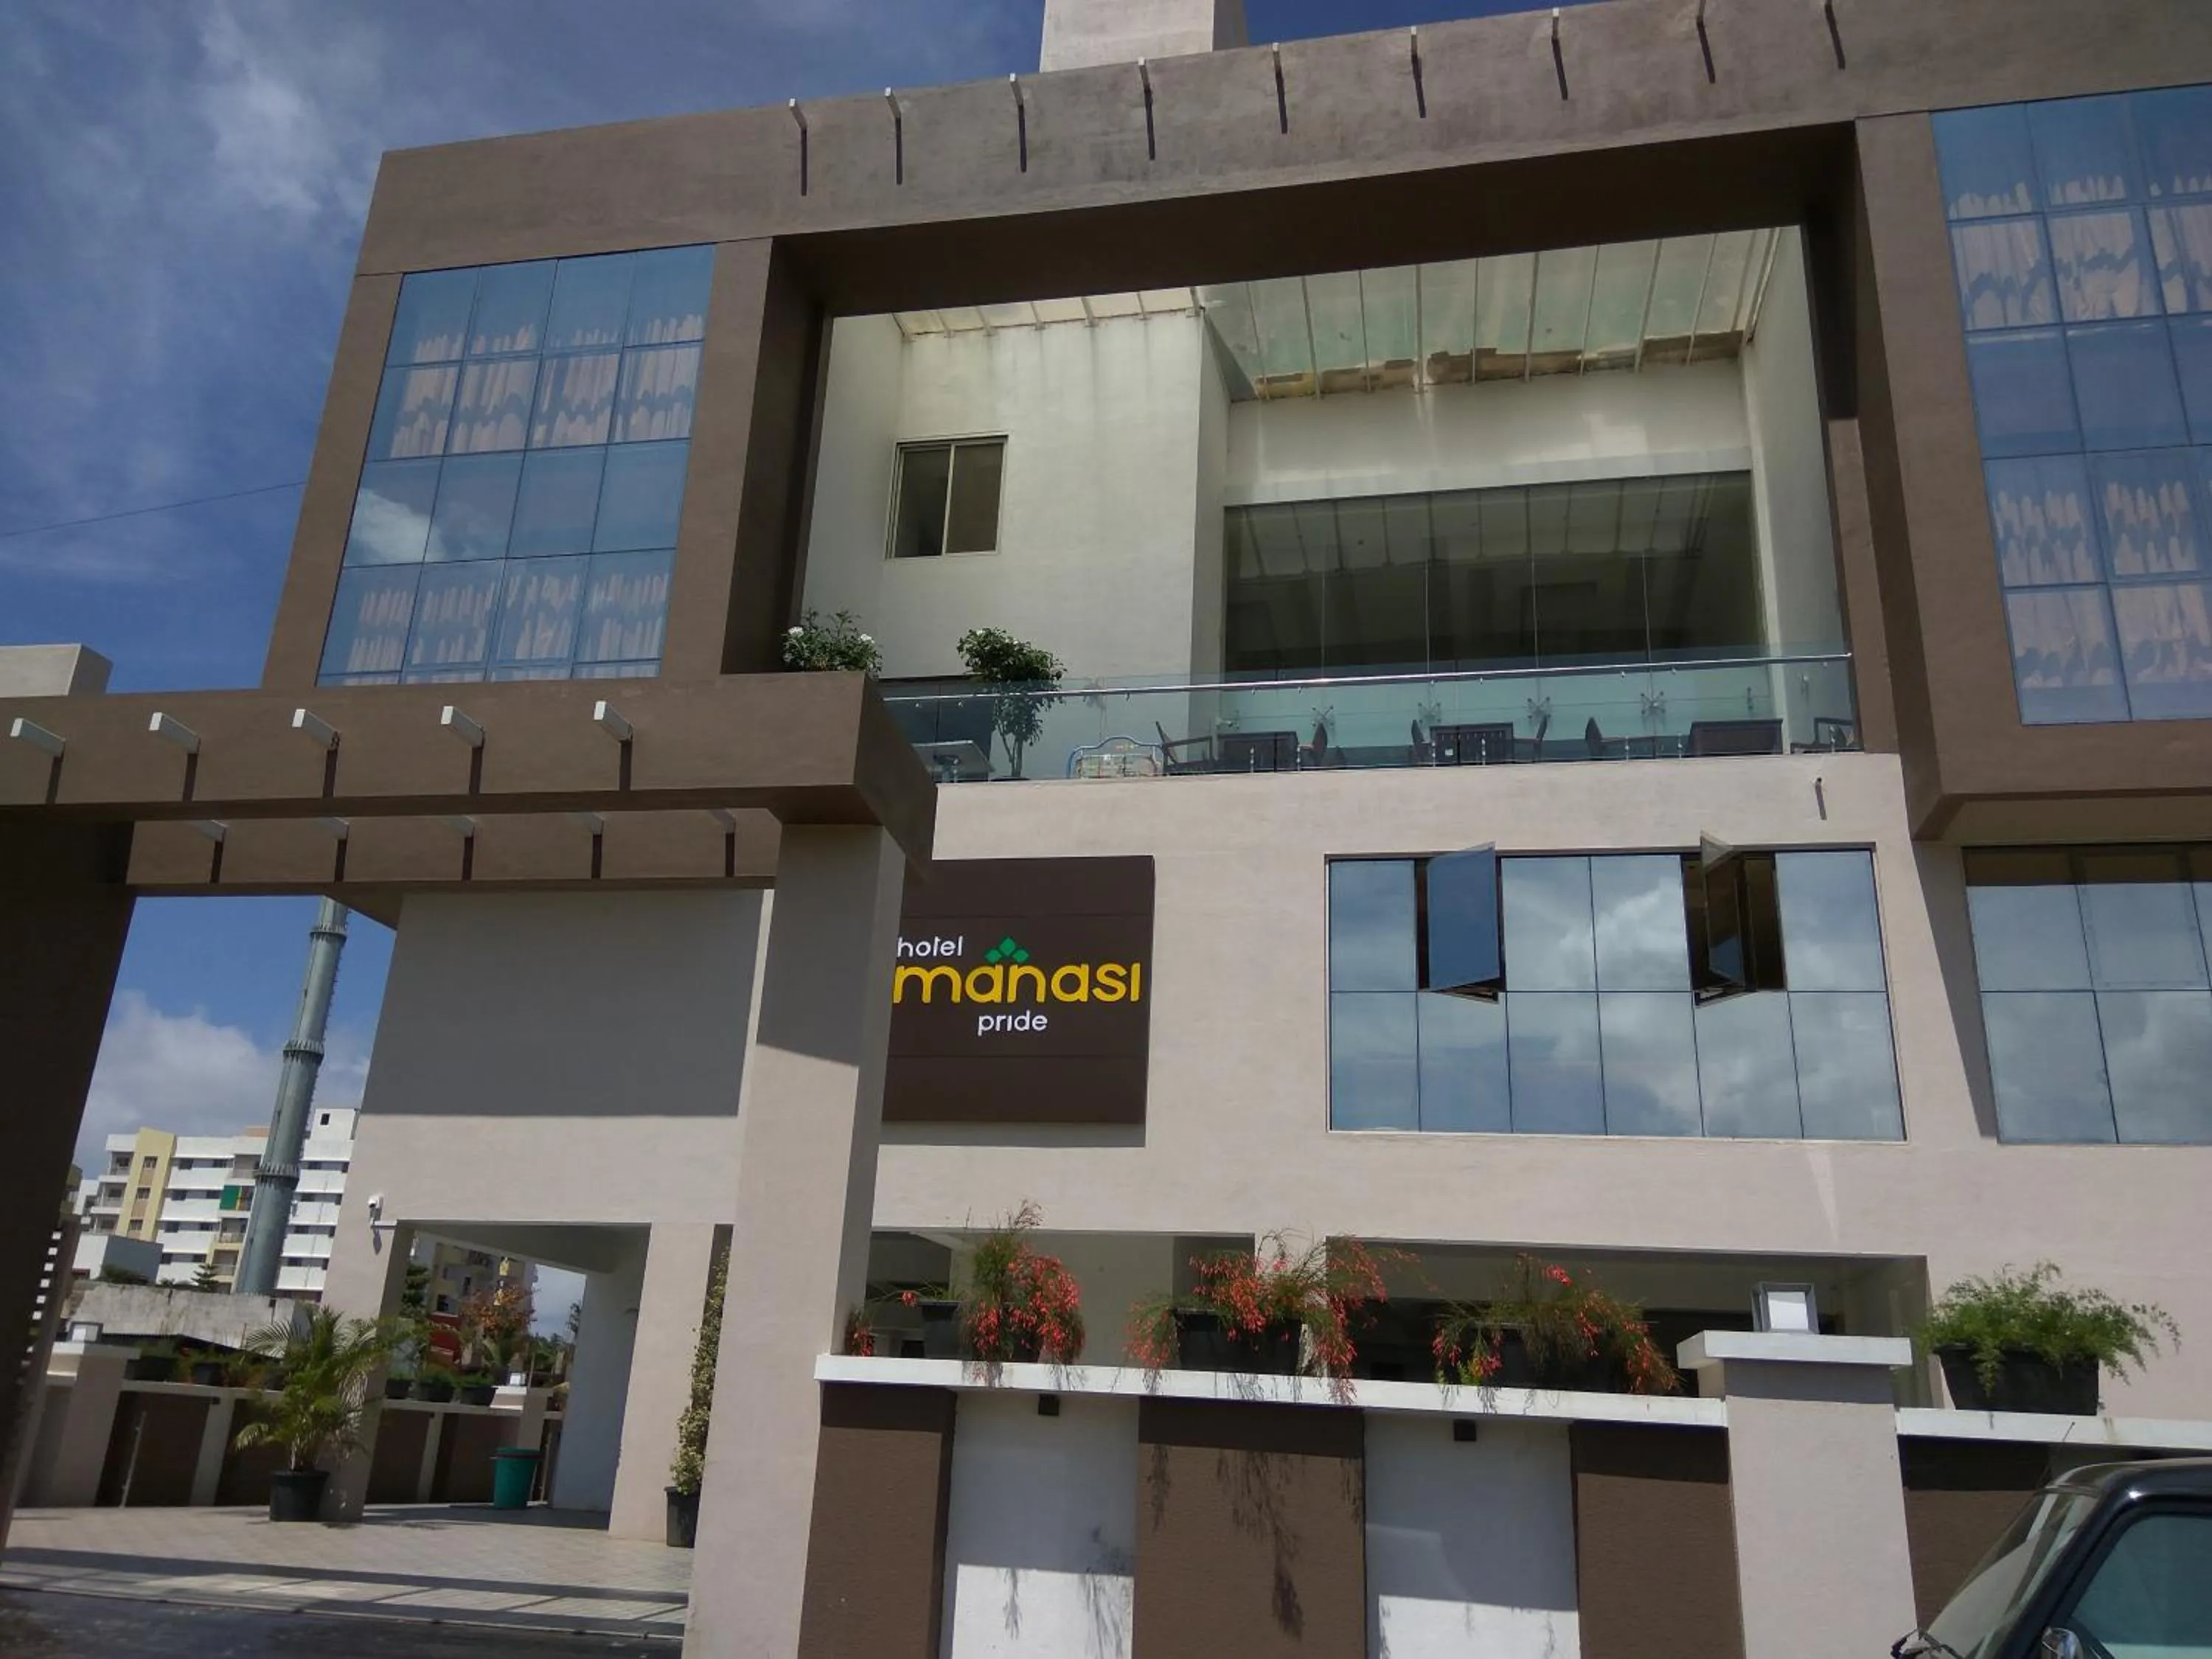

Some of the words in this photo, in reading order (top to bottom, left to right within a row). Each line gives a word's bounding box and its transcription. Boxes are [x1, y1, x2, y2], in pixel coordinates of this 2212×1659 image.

[897, 936, 963, 957] hotel
[893, 963, 1140, 1003] manasi
[978, 1010, 1048, 1036] pride
